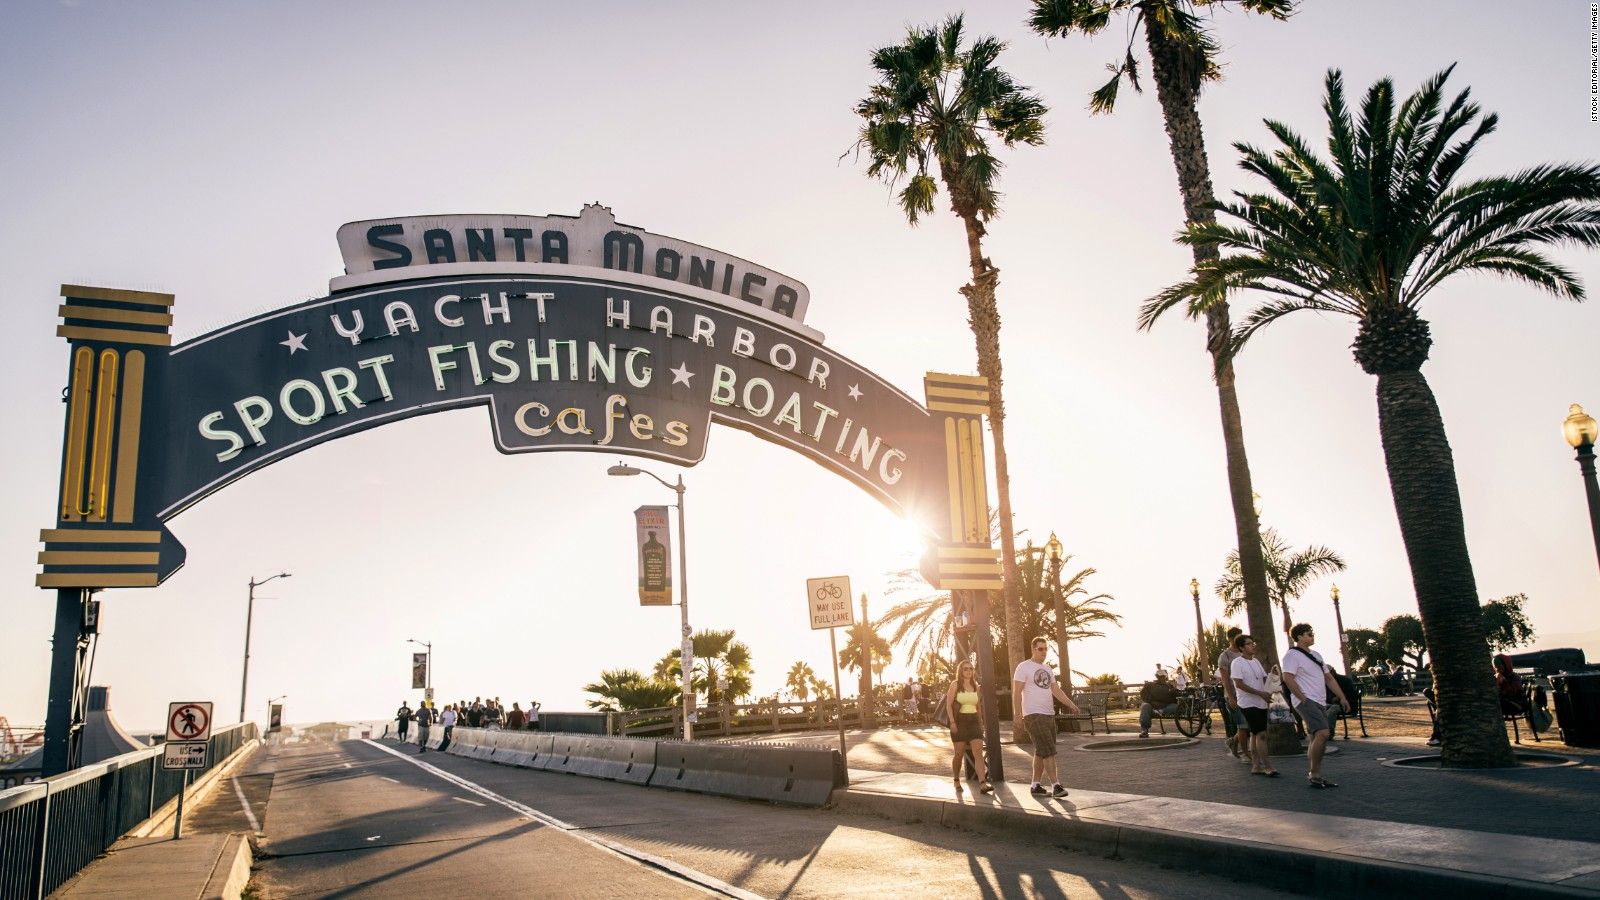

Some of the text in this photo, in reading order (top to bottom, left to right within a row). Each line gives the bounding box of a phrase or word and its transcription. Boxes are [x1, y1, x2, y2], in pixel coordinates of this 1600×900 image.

[366, 223, 800, 319] SANTA MONICA
[330, 292, 831, 390] YACHT HARBOR
[198, 338, 907, 485] SPORT FISHING BOATING
[816, 602, 845, 611] MAY USE
[814, 612, 849, 624] FULL LANE
[180, 746, 192, 755] USE
[165, 757, 203, 766] CROSSWALK
